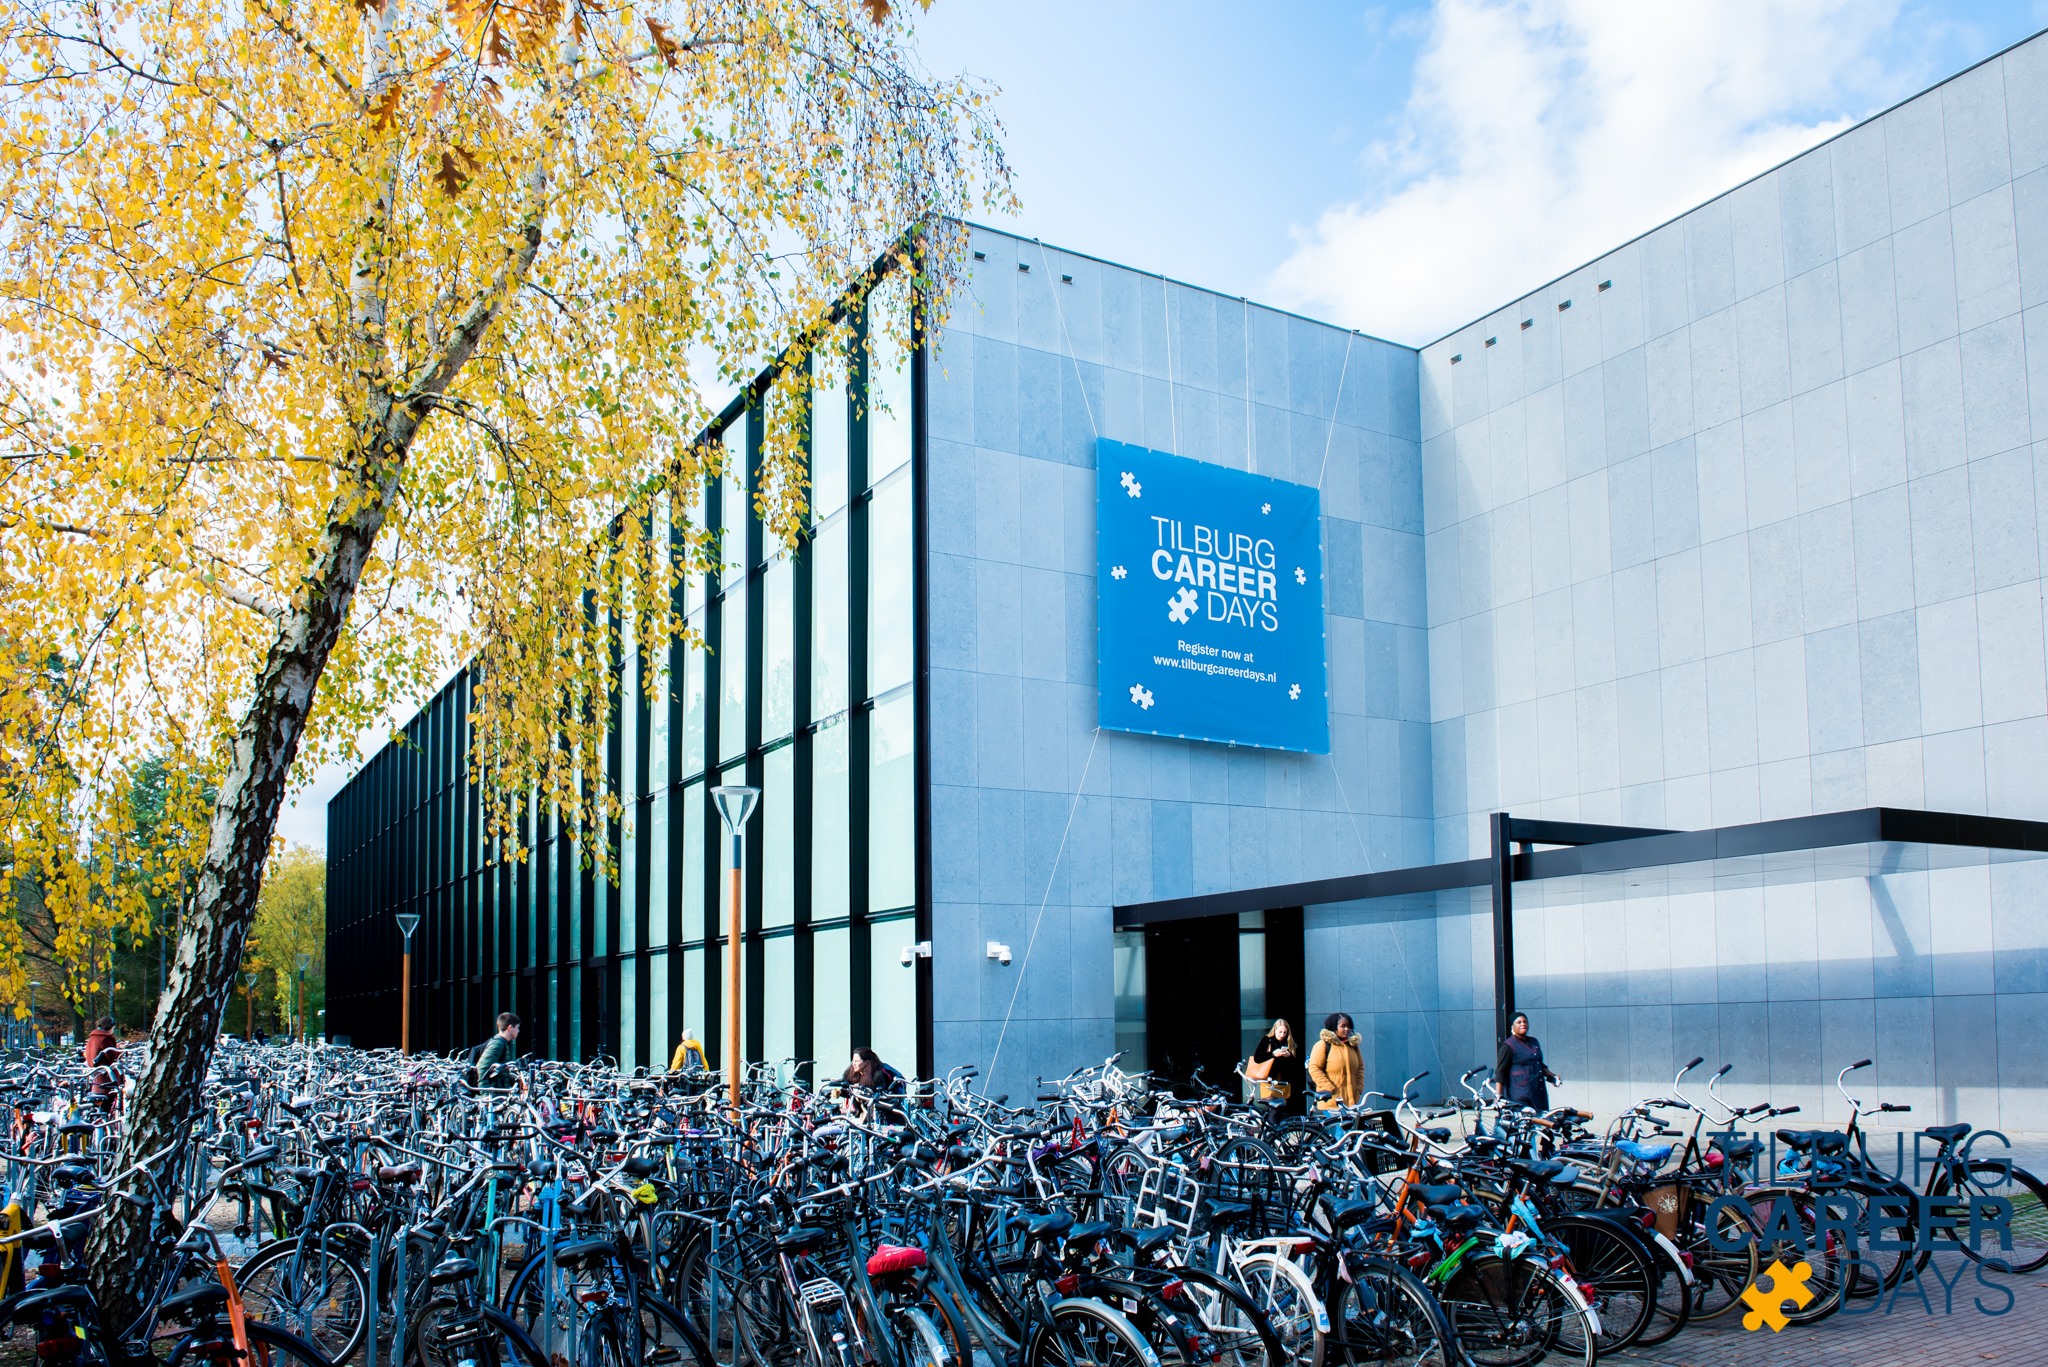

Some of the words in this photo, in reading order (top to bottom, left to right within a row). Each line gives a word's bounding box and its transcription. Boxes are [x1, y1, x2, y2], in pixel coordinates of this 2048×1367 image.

[1151, 515, 1276, 570] TILBURG
[1151, 549, 1278, 601] CAREER
[1207, 591, 1279, 633] DAYS
[1153, 655, 1277, 683] www.tilburgcareerdays.nl
[1178, 640, 1219, 657] Register
[1221, 648, 1241, 661] now
[1243, 651, 1254, 663] at
